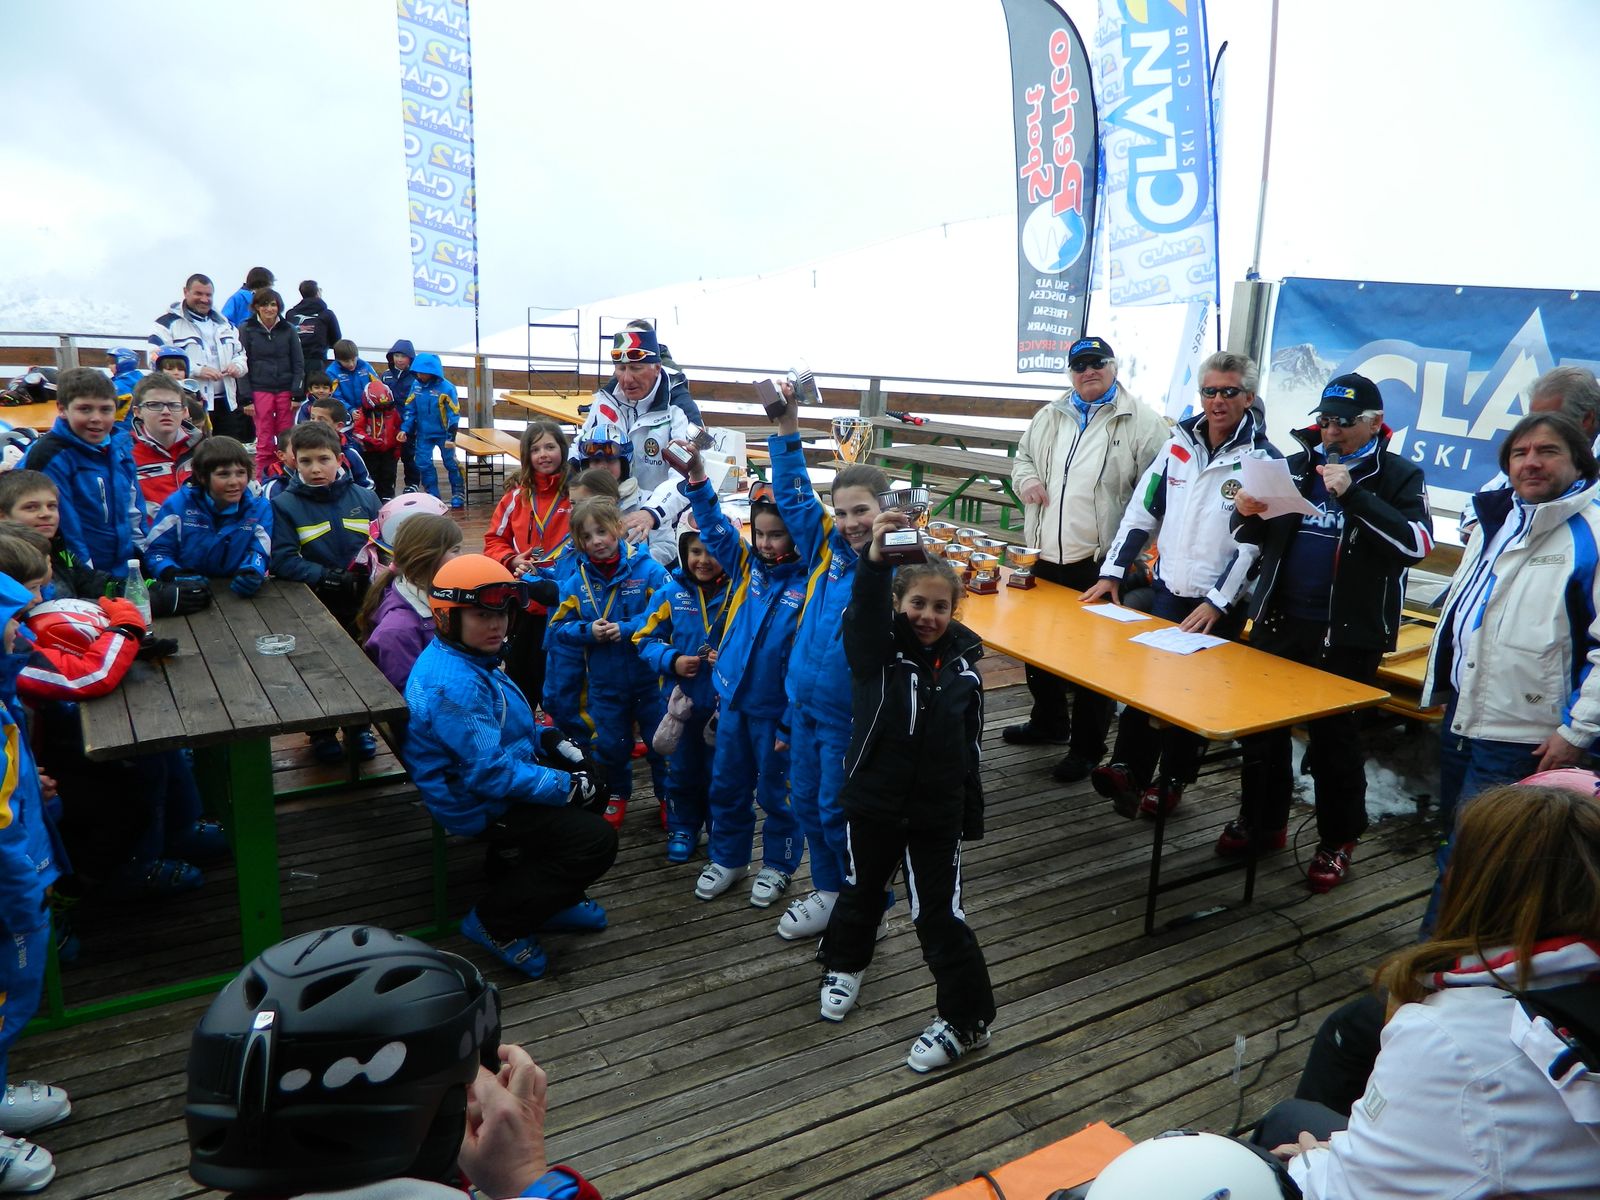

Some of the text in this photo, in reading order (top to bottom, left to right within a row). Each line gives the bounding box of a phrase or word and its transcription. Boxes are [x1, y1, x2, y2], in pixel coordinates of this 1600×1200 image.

[1175, 25, 1192, 87] CLUB
[1182, 128, 1197, 167] SKI
[644, 455, 663, 466] Bruno
[1410, 440, 1473, 471] SKI
